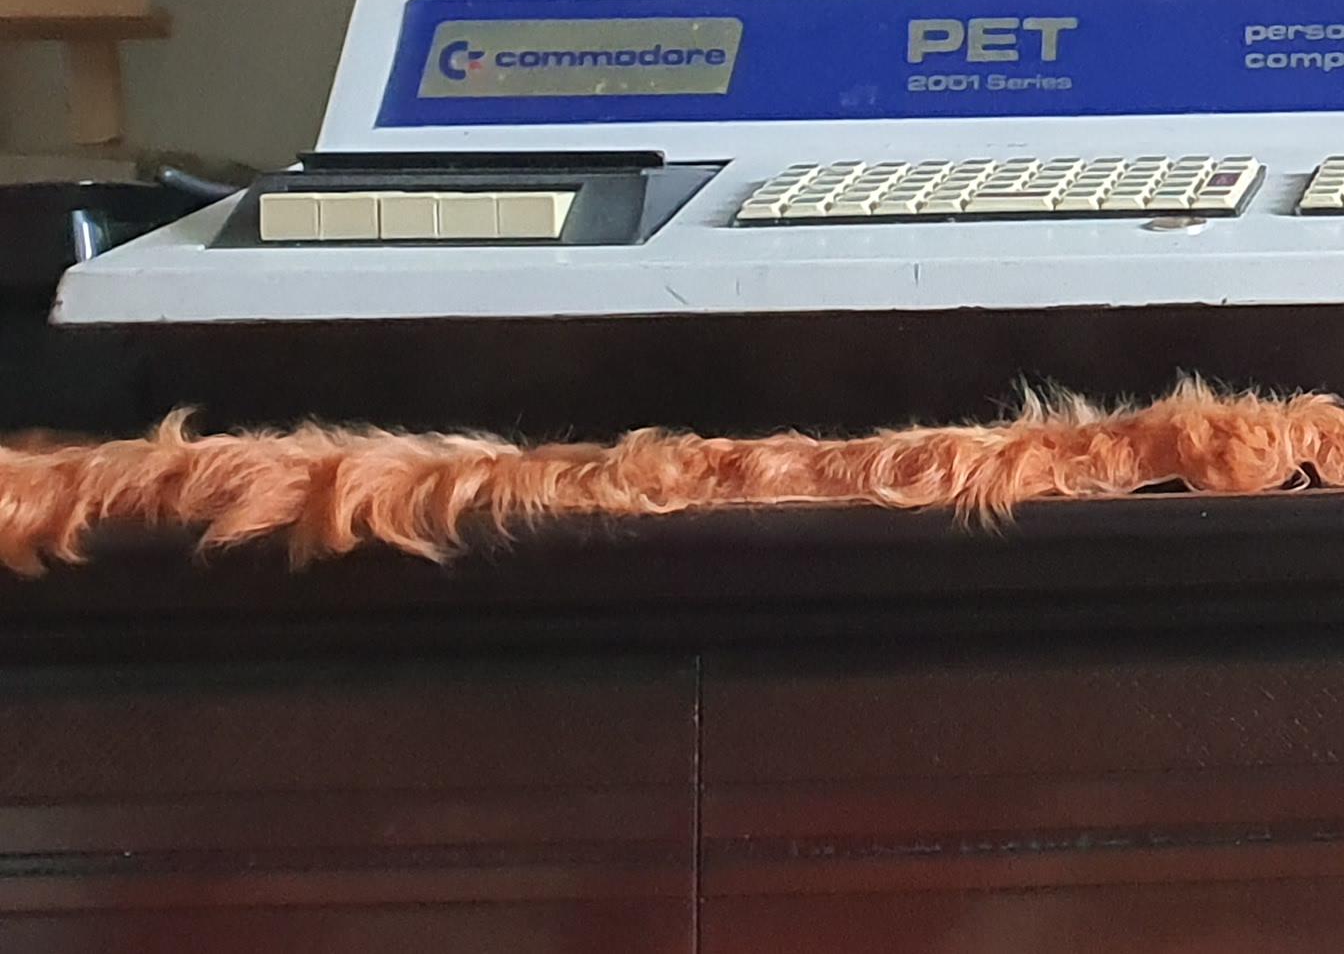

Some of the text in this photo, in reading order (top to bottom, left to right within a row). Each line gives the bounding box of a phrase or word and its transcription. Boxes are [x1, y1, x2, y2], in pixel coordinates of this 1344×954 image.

[907, 17, 1078, 63] PET
[495, 44, 727, 68] commodore
[907, 74, 1073, 92] 2001 Series
